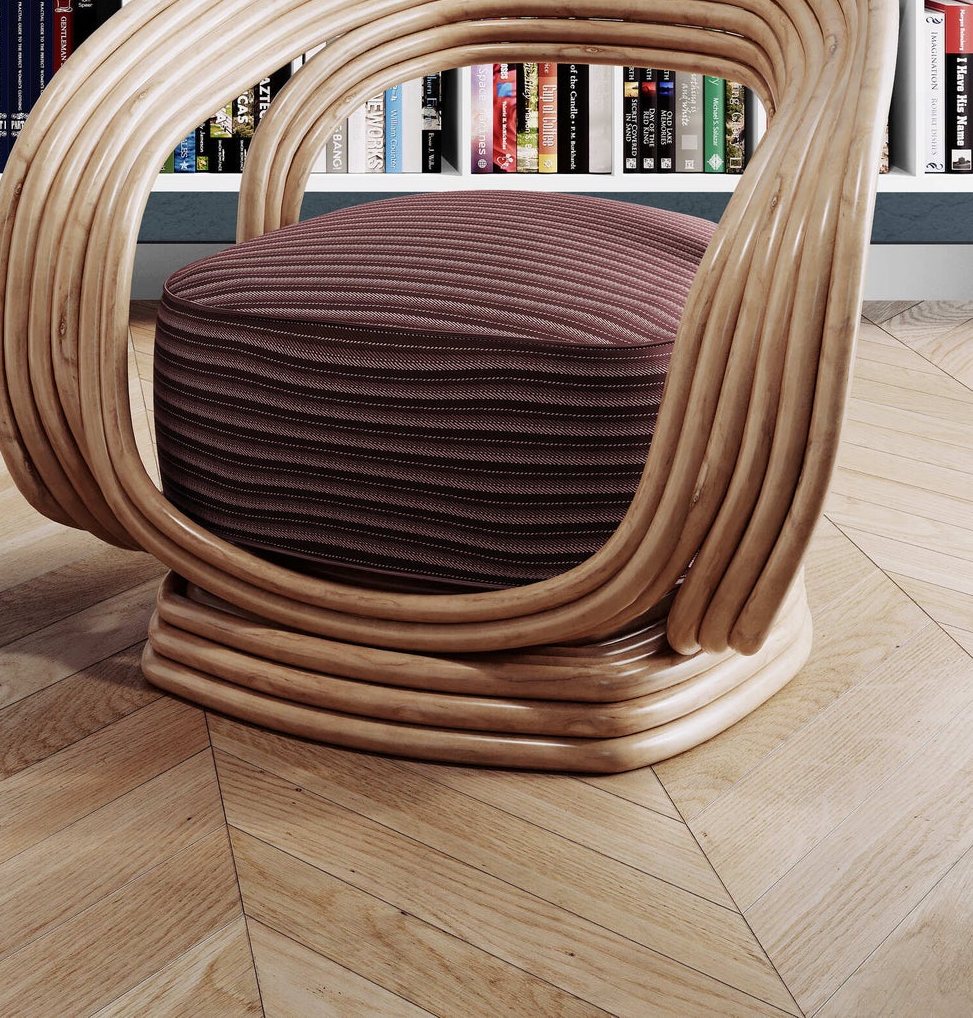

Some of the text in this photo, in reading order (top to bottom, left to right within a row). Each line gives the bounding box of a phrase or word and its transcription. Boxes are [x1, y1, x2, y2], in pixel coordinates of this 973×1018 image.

[570, 65, 577, 74] of
[957, 65, 967, 92] Have
[540, 84, 557, 102] Cup
[957, 94, 967, 113] His
[626, 113, 631, 121] IN
[543, 117, 557, 146] Coffee
[649, 124, 655, 133] OF
[957, 115, 967, 146] Name
[333, 134, 342, 170] BANG!
